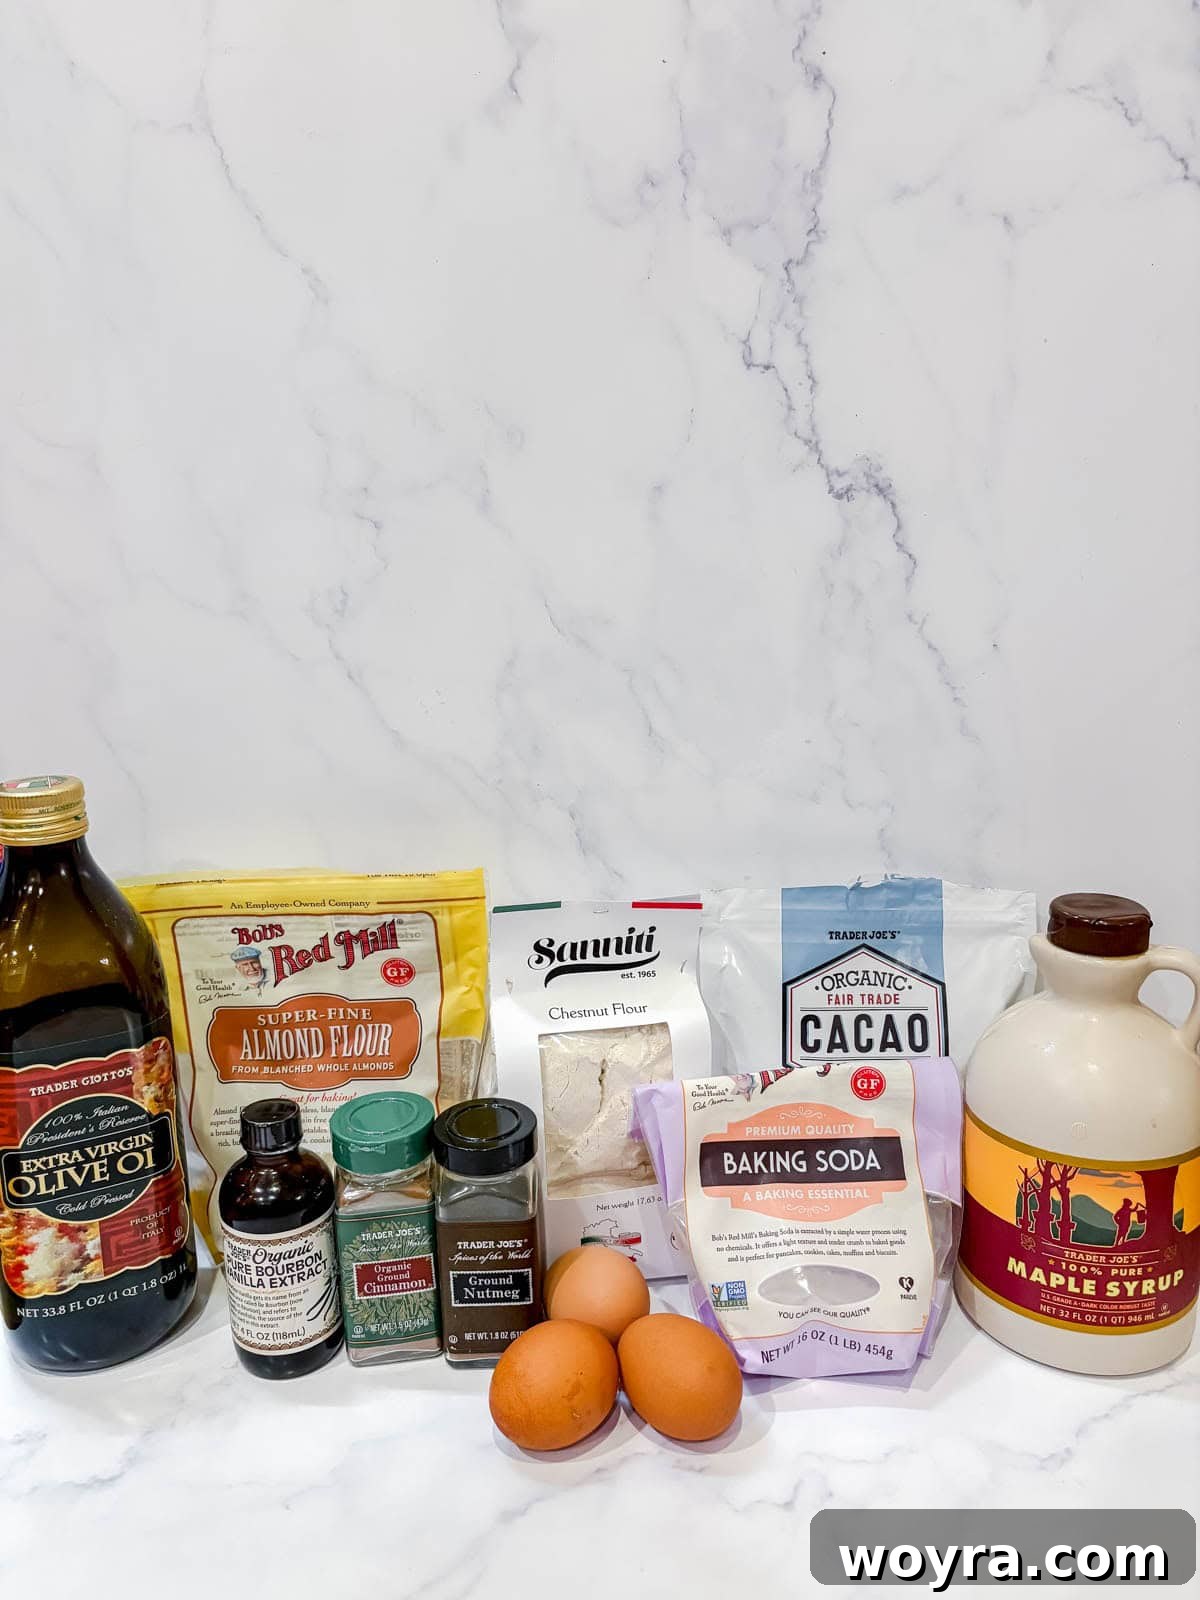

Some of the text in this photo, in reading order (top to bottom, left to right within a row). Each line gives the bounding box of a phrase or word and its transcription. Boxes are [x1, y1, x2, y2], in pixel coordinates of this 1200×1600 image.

[328, 899, 370, 908] Company
[231, 923, 285, 945] Bob's
[828, 931, 896, 940] TRADER JOE'S
[268, 918, 400, 988] Red Mill
[528, 925, 657, 970] Sanniti
[638, 970, 656, 978] 1965
[821, 971, 908, 991] ORGANIC
[828, 994, 900, 1005] FAIR TRADE
[258, 1008, 372, 1026] SUPER-FINE
[549, 1003, 648, 1020] Chestnut Flour
[800, 1013, 929, 1053] CACAO
[240, 1024, 393, 1061] ALMOND FLOUR
[232, 1062, 394, 1073] FROM BLANCHED WHOLE ALMONDS
[29, 1067, 134, 1096] TRADER GIOTTO'S
[857, 1079, 880, 1089] GF
[304, 1093, 319, 1104] for
[45, 1103, 129, 1129] 100% Italian
[213, 1107, 237, 1115] Almond
[27, 1114, 147, 1145] President's Reserve
[746, 1123, 855, 1136] PREMIUM QUALITY
[20, 1131, 155, 1173] EXTRA VIRGIN
[723, 1149, 881, 1174] BAKING SODA
[8, 1157, 110, 1198] OLIVE
[56, 1189, 136, 1215] Cold Pressed
[743, 1188, 869, 1202] A BAKING ESSENTIAL
[130, 1207, 171, 1226] PRODUCT
[141, 1226, 165, 1240] ITALY
[361, 1227, 421, 1241] TRADER JOE'S
[728, 1233, 740, 1241] Red
[759, 1230, 778, 1238] Baking
[457, 1240, 523, 1249] TRADER JOE'S
[252, 1240, 314, 1265] Organic
[508, 1248, 534, 1259] World
[1064, 1251, 1139, 1264] TRADER JOE'S
[255, 1250, 323, 1276] BOURBON
[374, 1262, 412, 1274] Organic
[1061, 1261, 1143, 1276] 100% PURE
[270, 1258, 328, 1289] EXTRACT
[377, 1272, 410, 1282] Ground
[469, 1275, 513, 1286] Ground
[1007, 1257, 1184, 1297] MAPLE SYRUP
[16, 1307, 39, 1318] NET
[42, 1305, 66, 1318] 33.8
[70, 1302, 84, 1313] FL
[86, 1294, 105, 1307] OZ
[108, 1291, 118, 1302] (1
[121, 1286, 139, 1297] QT
[142, 1278, 157, 1291] 1.8
[159, 1270, 177, 1285] OZ)
[364, 1279, 426, 1294] Cinnamon
[464, 1288, 520, 1299] Nutmeg
[778, 1311, 794, 1319] YOU
[796, 1310, 809, 1319] CAN
[823, 1310, 838, 1318] OUR
[1040, 1304, 1056, 1314] NET
[1060, 1309, 1069, 1318] 32
[1073, 1312, 1082, 1320] FL
[1100, 1316, 1107, 1324] (1
[1111, 1316, 1125, 1324] QT)
[1128, 1315, 1142, 1323] 946
[246, 1326, 305, 1341] FL OZ (118mL)
[465, 1332, 476, 1340] NET
[761, 1330, 893, 1364] NET WT 16 OZ (1 LB) 454g
